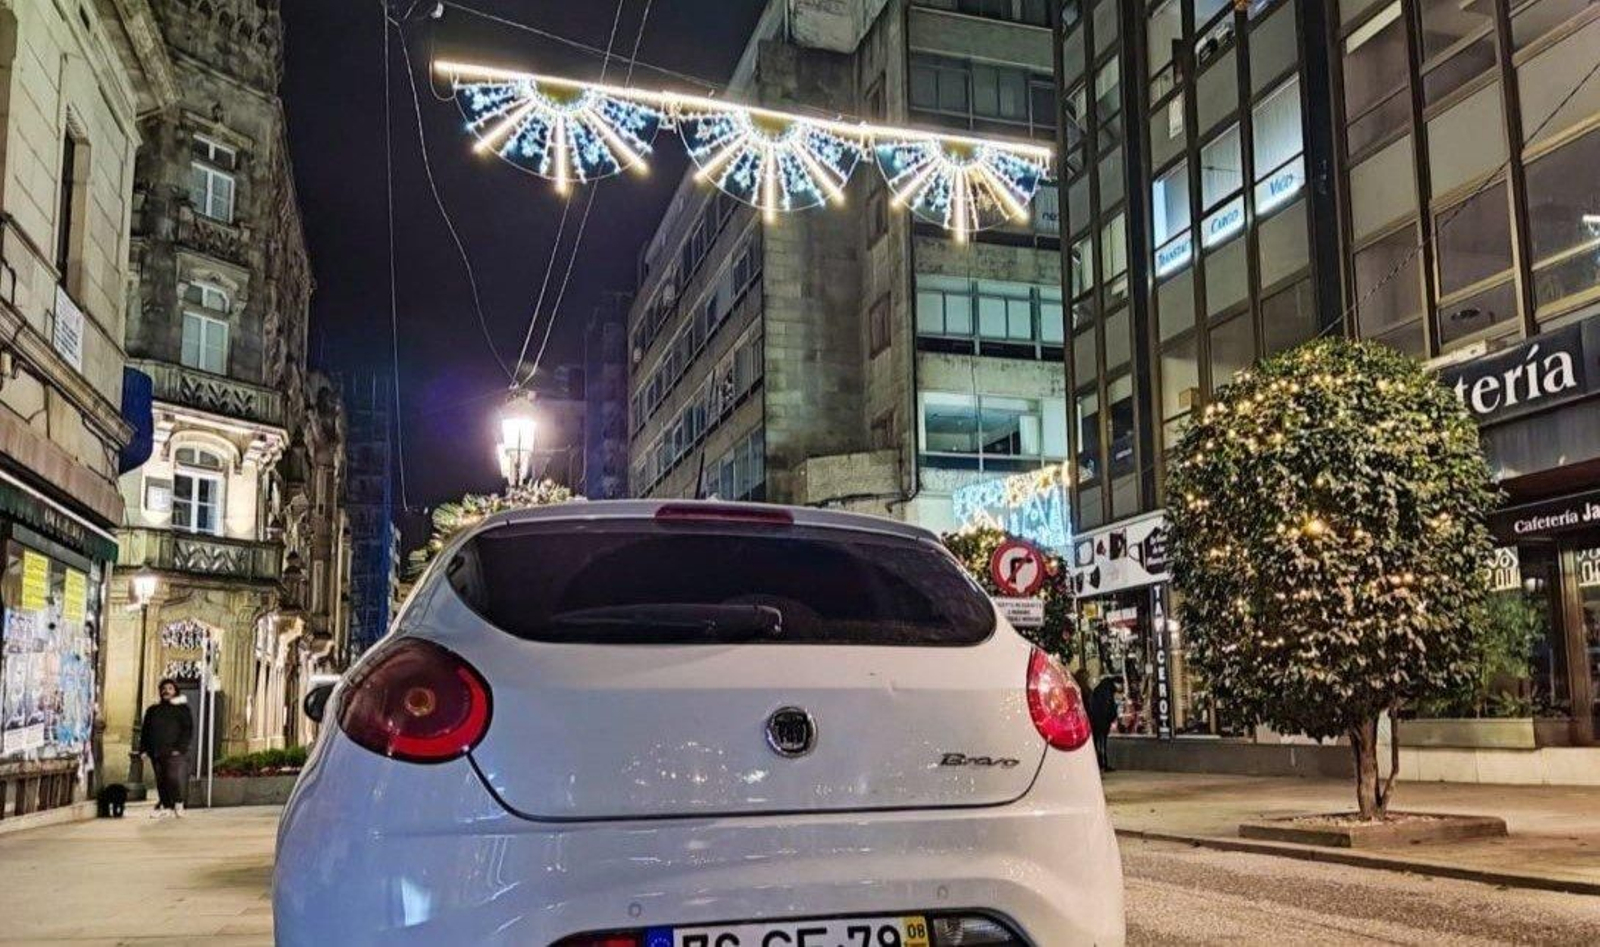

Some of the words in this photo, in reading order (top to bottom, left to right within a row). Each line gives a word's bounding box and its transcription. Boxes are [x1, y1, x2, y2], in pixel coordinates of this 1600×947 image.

[1454, 343, 1577, 414] tería
[1513, 509, 1579, 533] Cafetería
[941, 752, 1019, 768] Bravo
